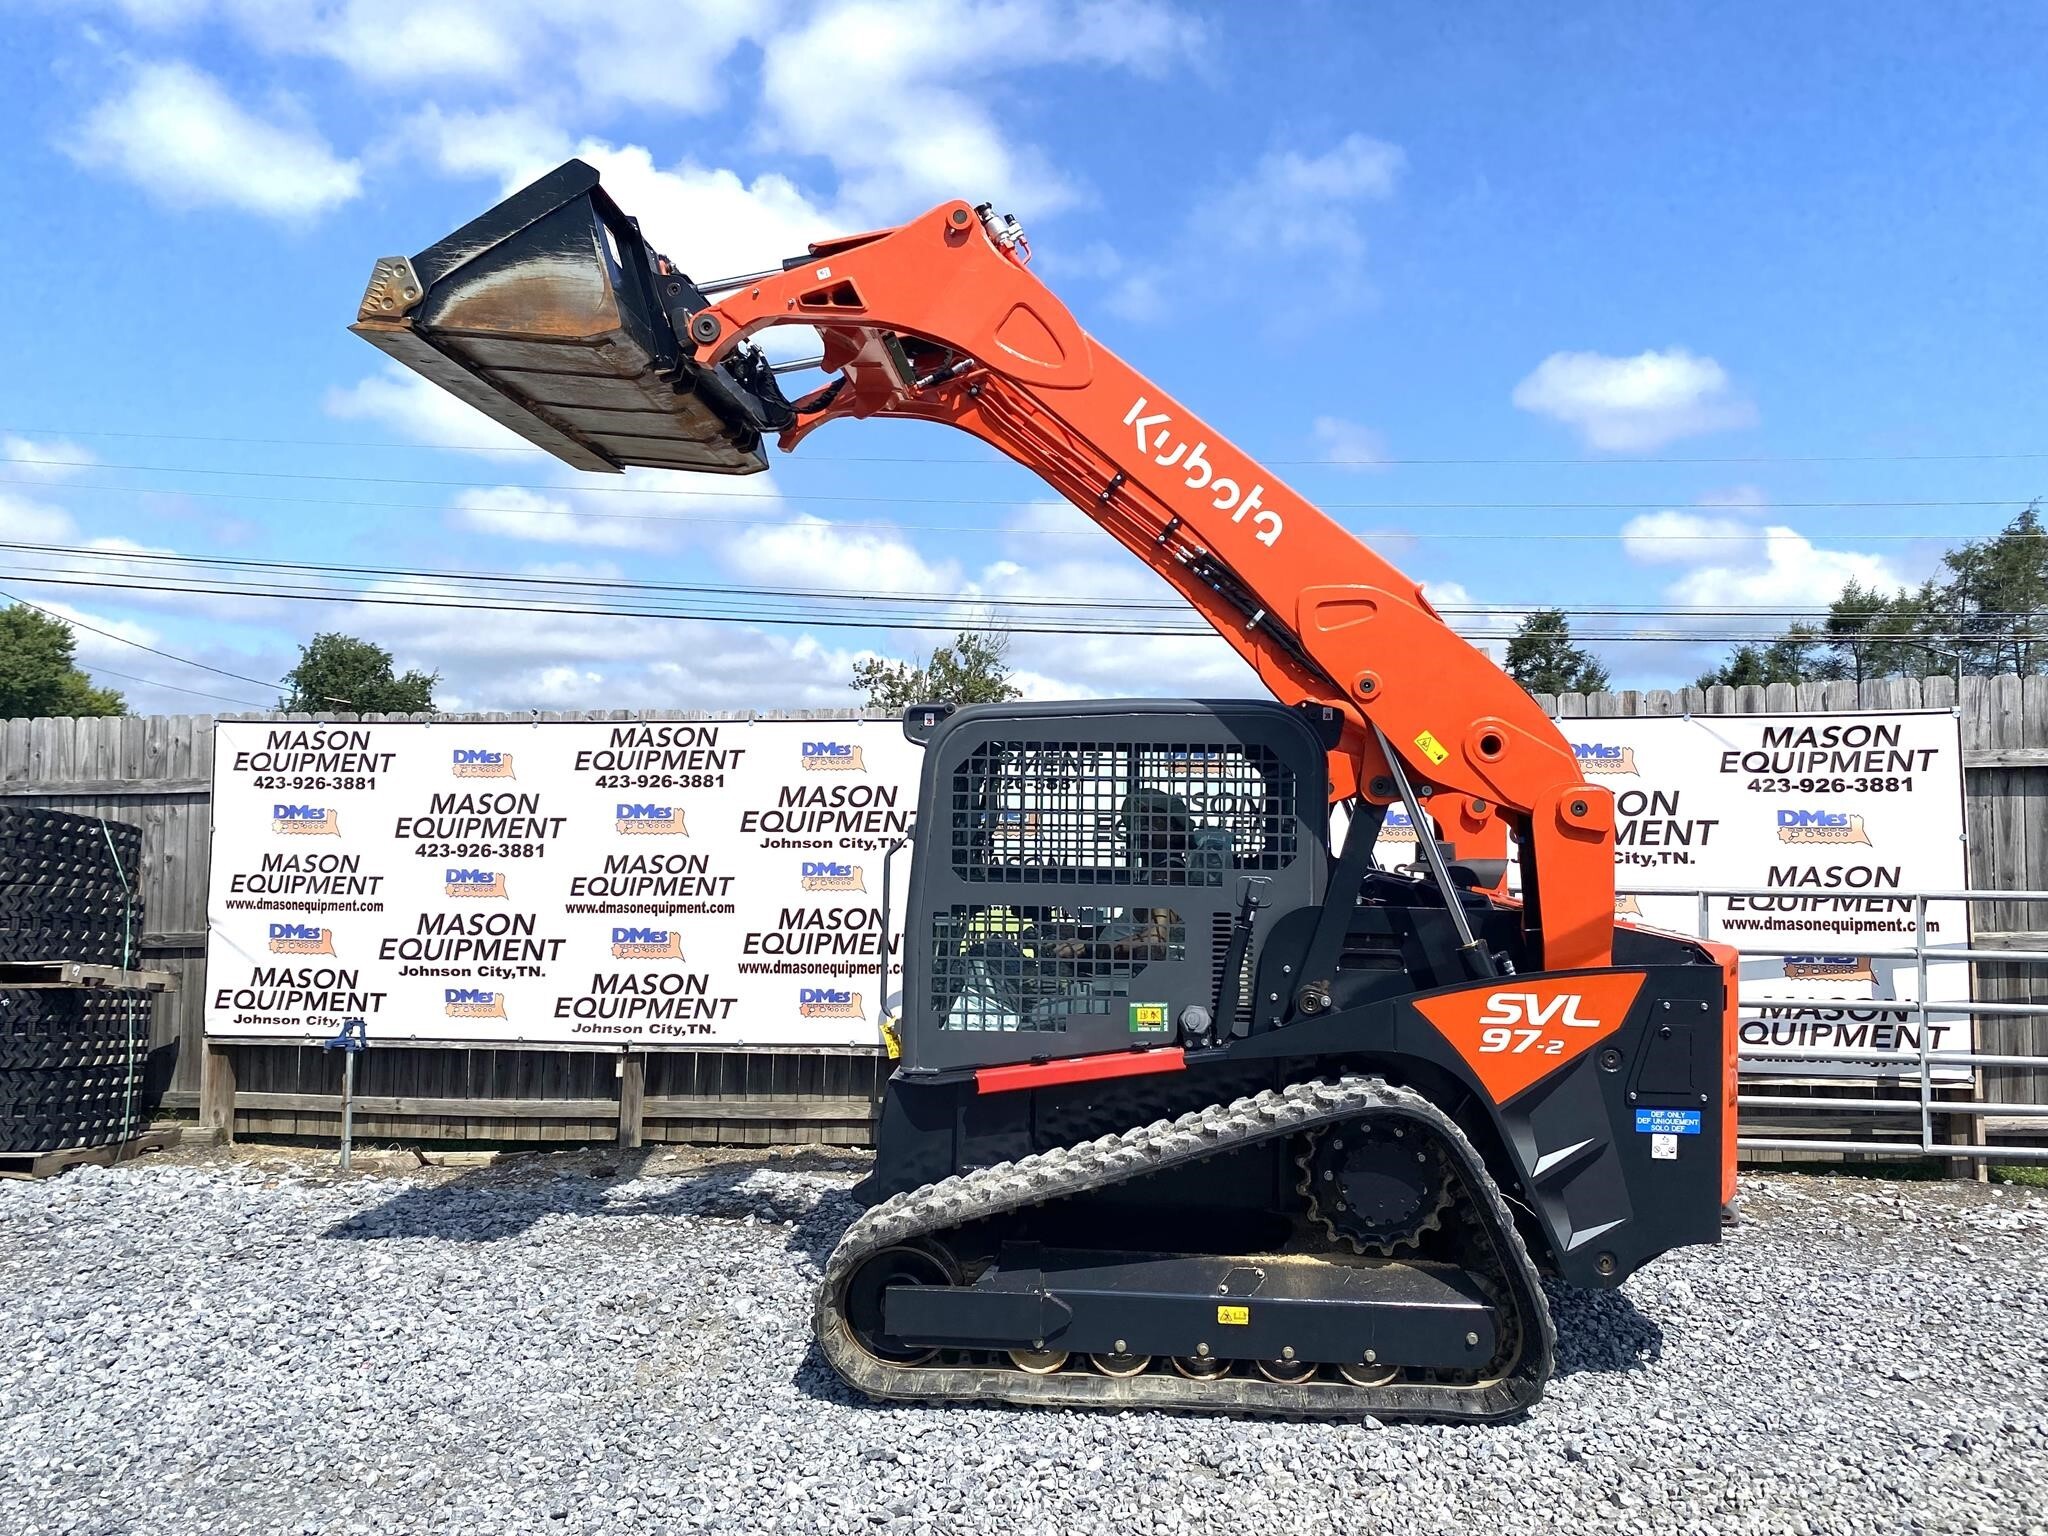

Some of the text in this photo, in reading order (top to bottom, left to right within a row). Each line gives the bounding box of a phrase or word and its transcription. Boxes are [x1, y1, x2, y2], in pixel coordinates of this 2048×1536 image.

[1123, 396, 1283, 548] Kubota
[267, 731, 370, 750] MASON
[610, 727, 718, 747] MASON
[1762, 725, 1901, 748] MASON
[234, 752, 396, 772] EQUIPMENT
[575, 750, 745, 770] EQUIPMENT
[1720, 749, 1938, 773] EQUIPMENT
[254, 776, 375, 789] 423-926-3881
[596, 775, 724, 788] 423-926-3881
[1748, 777, 1913, 792] 423-926-3881
[430, 793, 539, 814] MASON
[779, 786, 897, 807] MASON
[395, 818, 566, 838] EQUIPMENT
[416, 844, 544, 857] 423-926-3881
[760, 838, 832, 848] Johnson
[262, 854, 360, 873] MASON
[604, 855, 709, 874] MASON
[231, 874, 383, 895] EQUIPMENT
[571, 877, 734, 896] EQUIPMENT
[1768, 866, 1900, 887] MASON
[226, 898, 383, 914] www.dmasonequipment.com
[566, 901, 734, 916] www.dmasonequipment.com
[417, 914, 536, 935] MASON
[778, 908, 890, 930] MASON
[1722, 917, 1940, 935] www.dmasonequipment.cm
[379, 938, 566, 960] EQUIPMENT
[743, 933, 904, 955] EQUIPMEN
[251, 967, 358, 989] MASON
[399, 966, 545, 979] Johnson City,TN.
[738, 960, 904, 978] www.dmasonequipmen.c
[592, 974, 709, 995] MASON
[215, 990, 387, 1012] EQUIPMENT
[554, 997, 737, 1019] EQUIPMENT
[1478, 993, 1600, 1028] SVL
[233, 1014, 300, 1026] Johnson
[572, 1024, 715, 1036] Johnson City,TN.
[1478, 1029, 1566, 1055] 97-2
[1739, 1021, 1950, 1049] QUIPMENT
